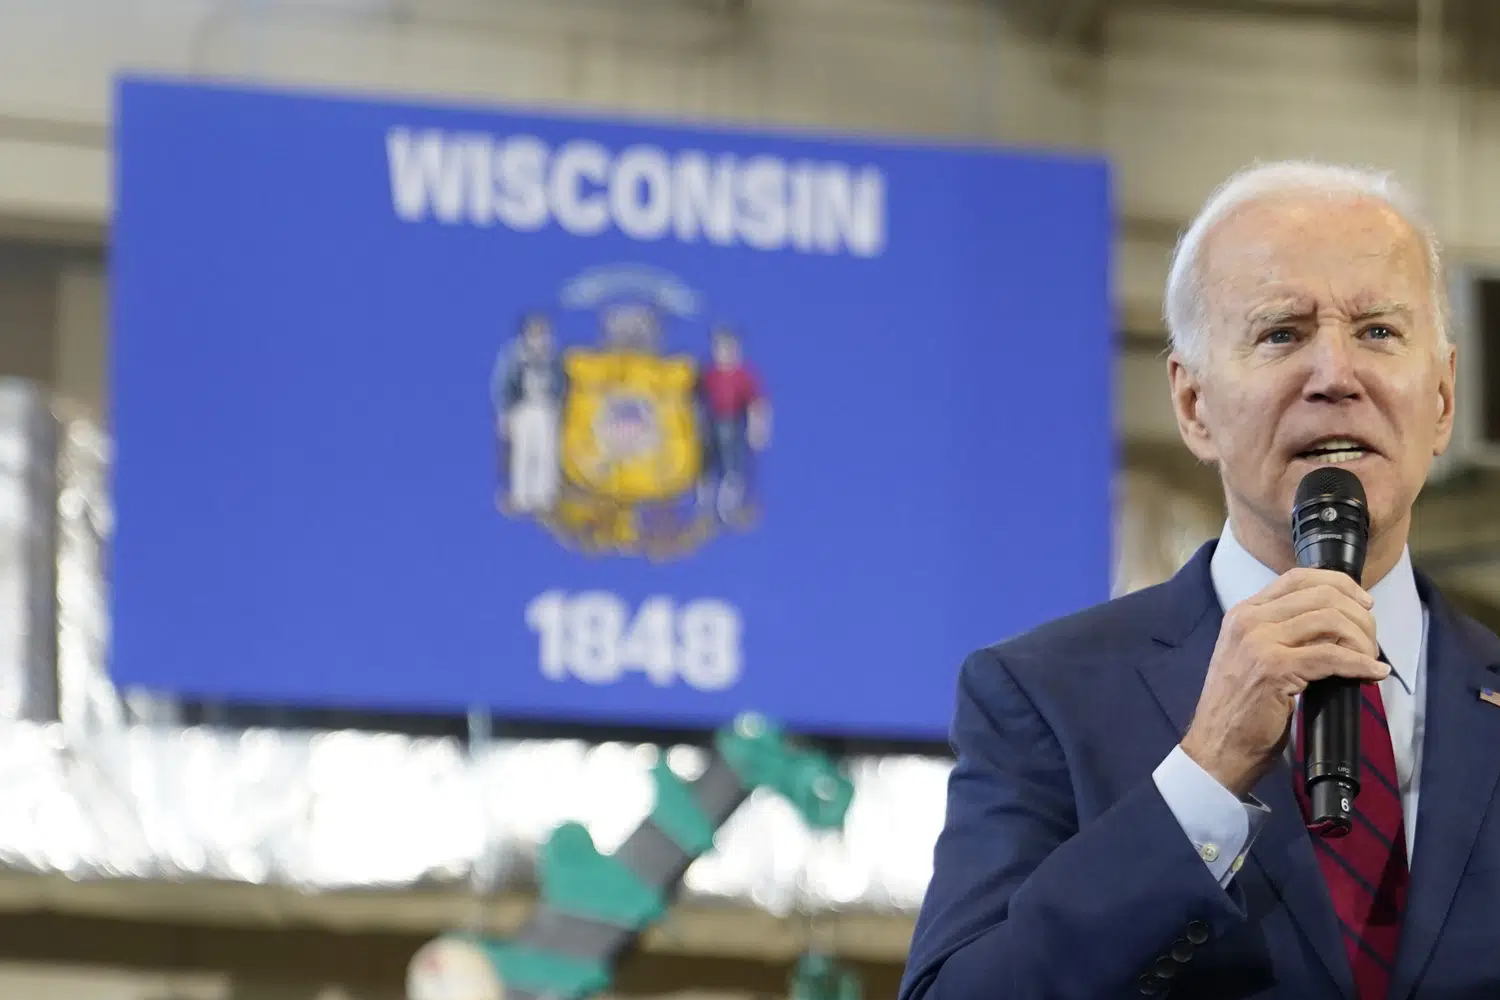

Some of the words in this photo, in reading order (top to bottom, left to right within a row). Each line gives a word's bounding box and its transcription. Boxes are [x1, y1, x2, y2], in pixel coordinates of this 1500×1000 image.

[387, 126, 885, 257] WISCONSIN
[525, 589, 744, 691] 1848
[1340, 797, 1350, 812] 6
